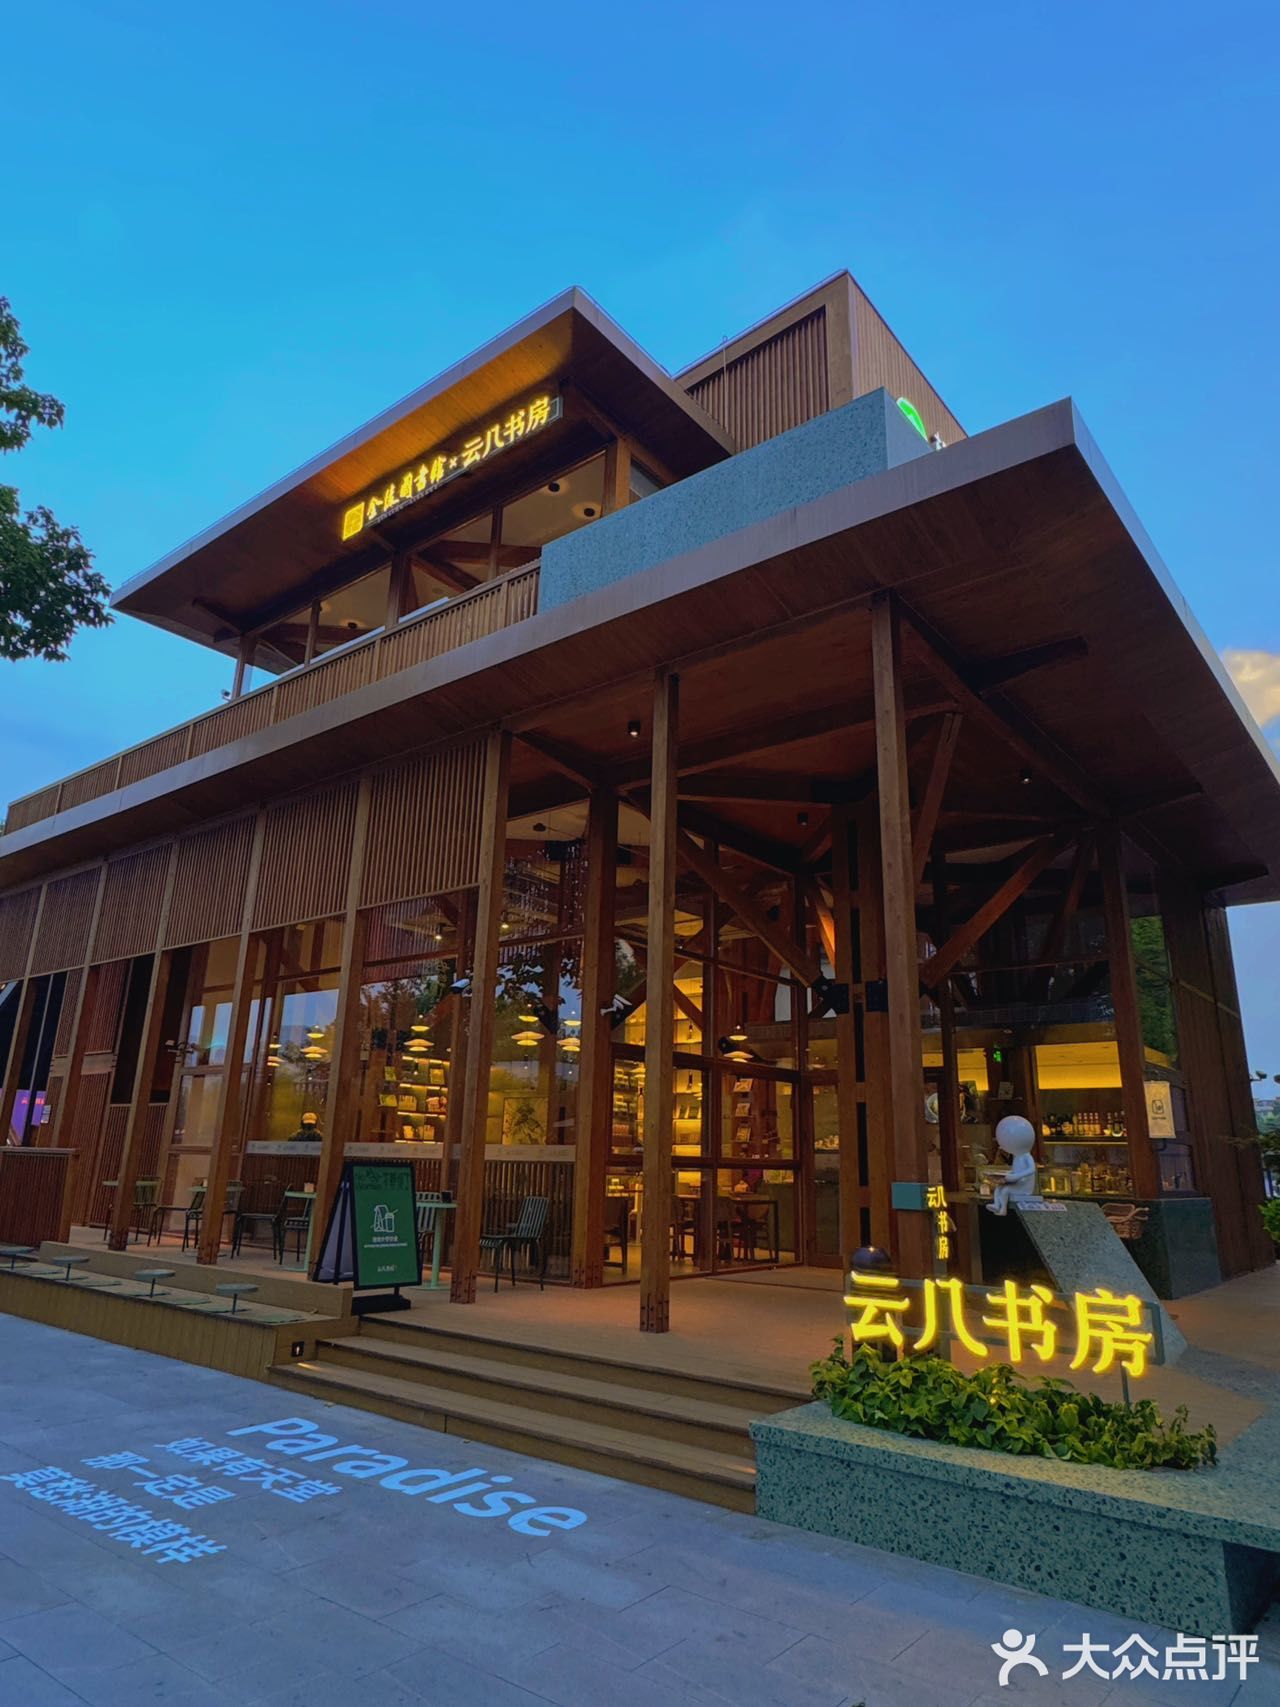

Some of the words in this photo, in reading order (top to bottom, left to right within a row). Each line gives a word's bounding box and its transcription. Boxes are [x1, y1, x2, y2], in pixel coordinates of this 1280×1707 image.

[81, 1450, 236, 1510] 那一定是
[154, 1436, 344, 1503] 如果有天堂
[227, 1417, 588, 1537] Paradise
[0, 1465, 227, 1564] 莫愁湖的模样
